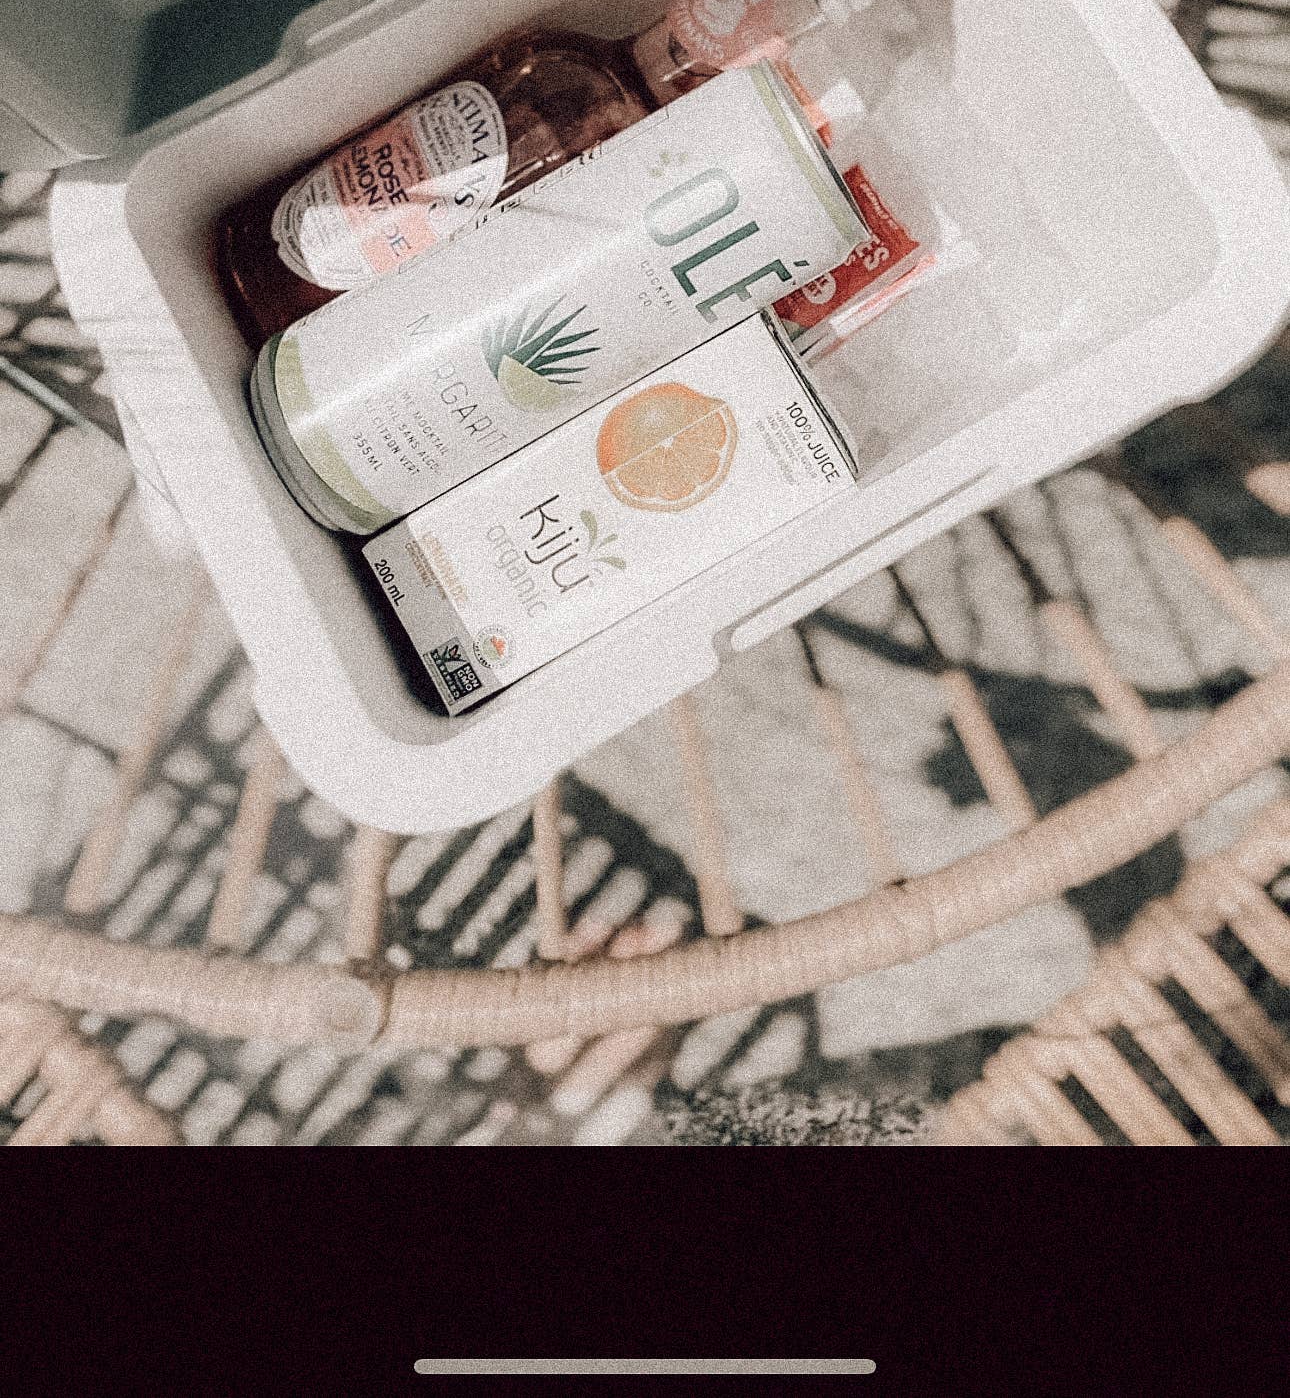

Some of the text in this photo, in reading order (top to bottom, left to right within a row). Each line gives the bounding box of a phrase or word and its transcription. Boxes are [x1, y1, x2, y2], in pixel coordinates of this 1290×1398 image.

[351, 144, 412, 257] EMONDE
[369, 142, 409, 207] ROSE
[644, 166, 809, 325] OLÉ
[638, 258, 680, 316] COCKTAIL
[405, 311, 510, 456] MRGARIT
[397, 422, 420, 449] SANS
[784, 400, 841, 483] 100% JUICE
[485, 524, 548, 618] organic
[518, 493, 591, 595] kiju
[373, 557, 406, 606] 200 mL
[456, 669, 473, 691] GMO
[462, 665, 479, 687] NON
